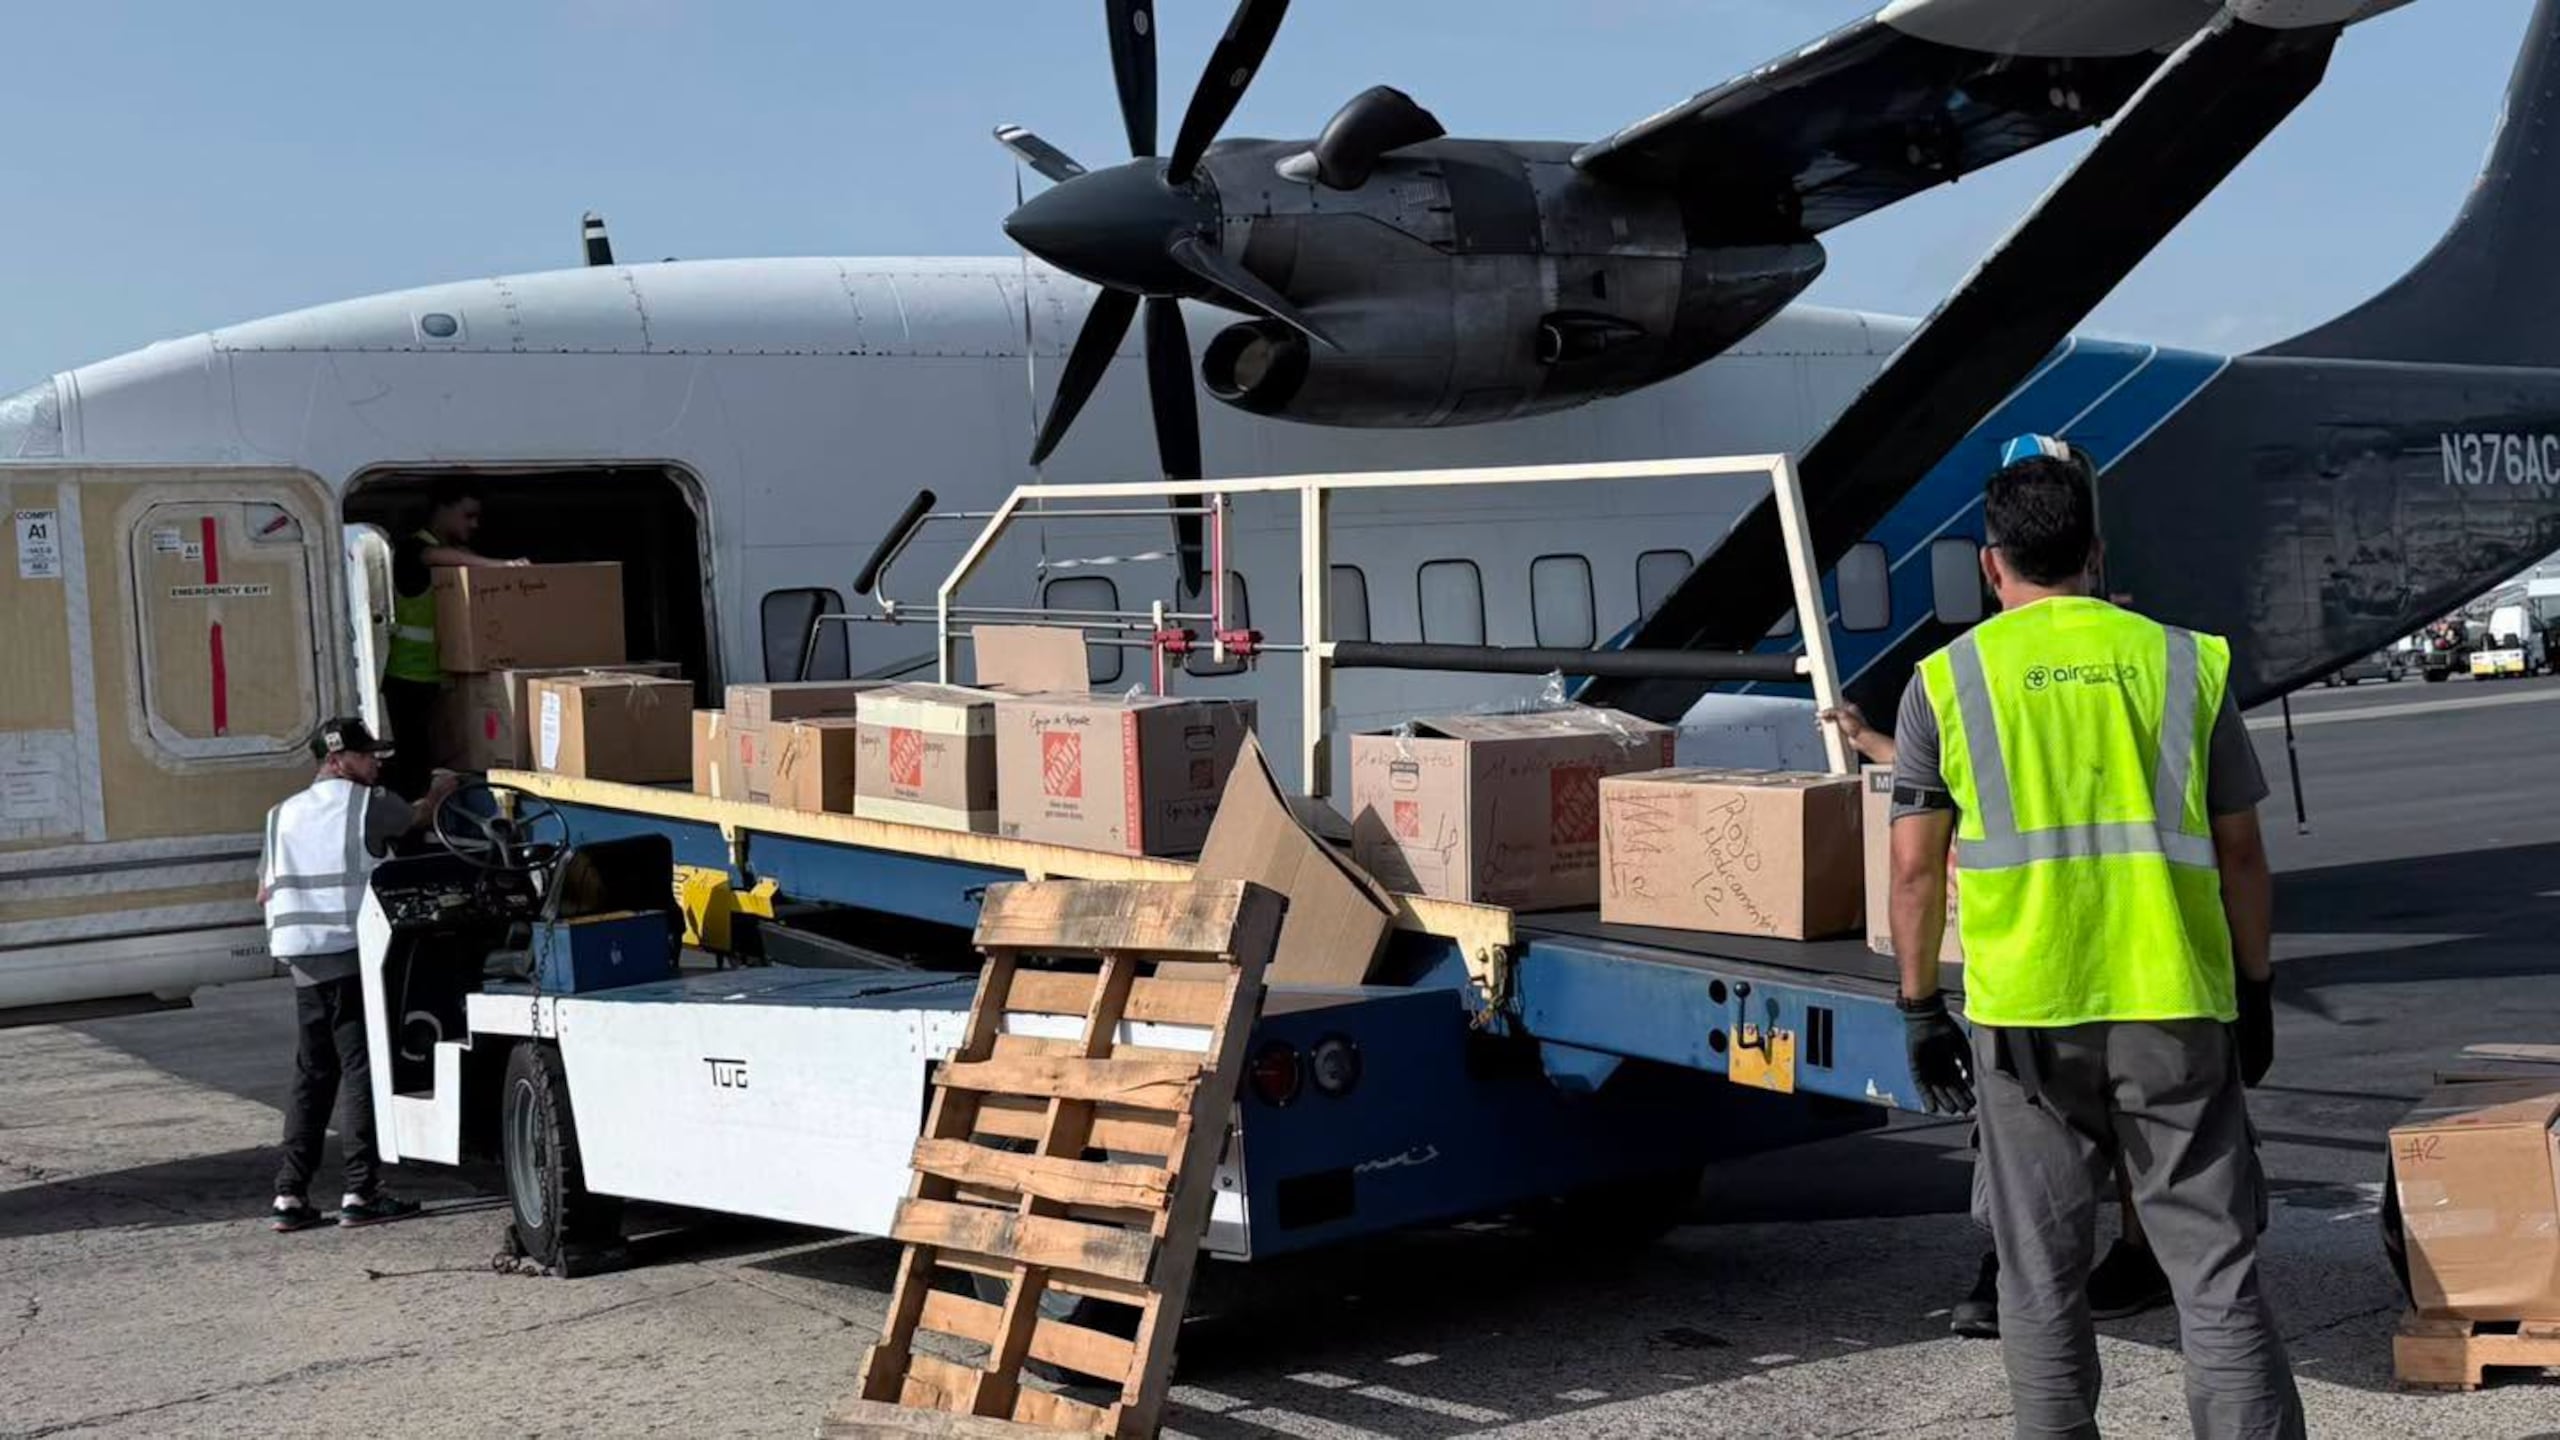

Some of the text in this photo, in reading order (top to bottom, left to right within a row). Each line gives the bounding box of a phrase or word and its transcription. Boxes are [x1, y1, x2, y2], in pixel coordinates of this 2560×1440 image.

[2441, 432, 2560, 485] N376AC
[28, 523, 47, 540] A1
[171, 585, 269, 597] EMERGENCY EXIT
